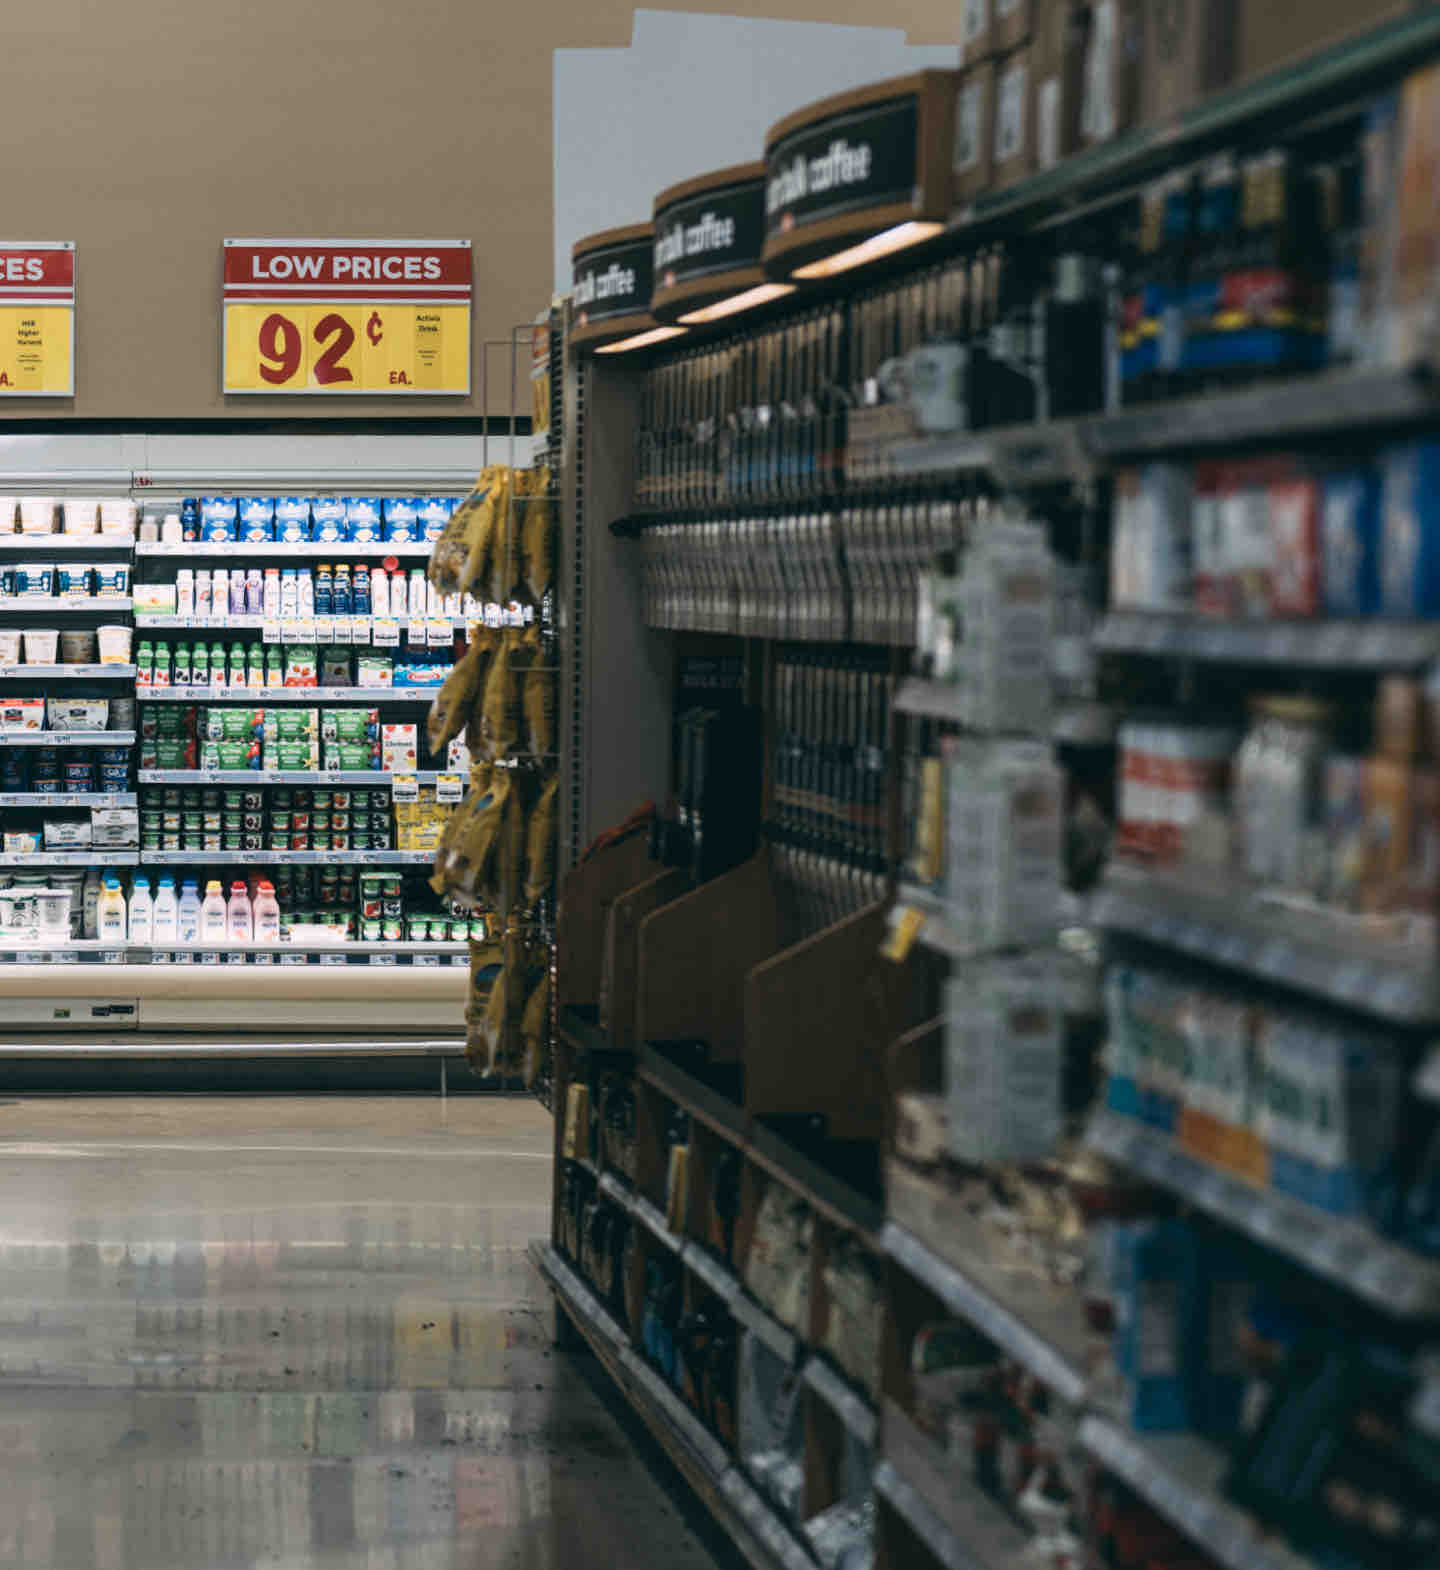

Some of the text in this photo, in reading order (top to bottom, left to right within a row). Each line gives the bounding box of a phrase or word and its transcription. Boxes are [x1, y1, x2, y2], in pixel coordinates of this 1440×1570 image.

[252, 255, 441, 279] LOW PRICES
[390, 371, 412, 385] EA.
